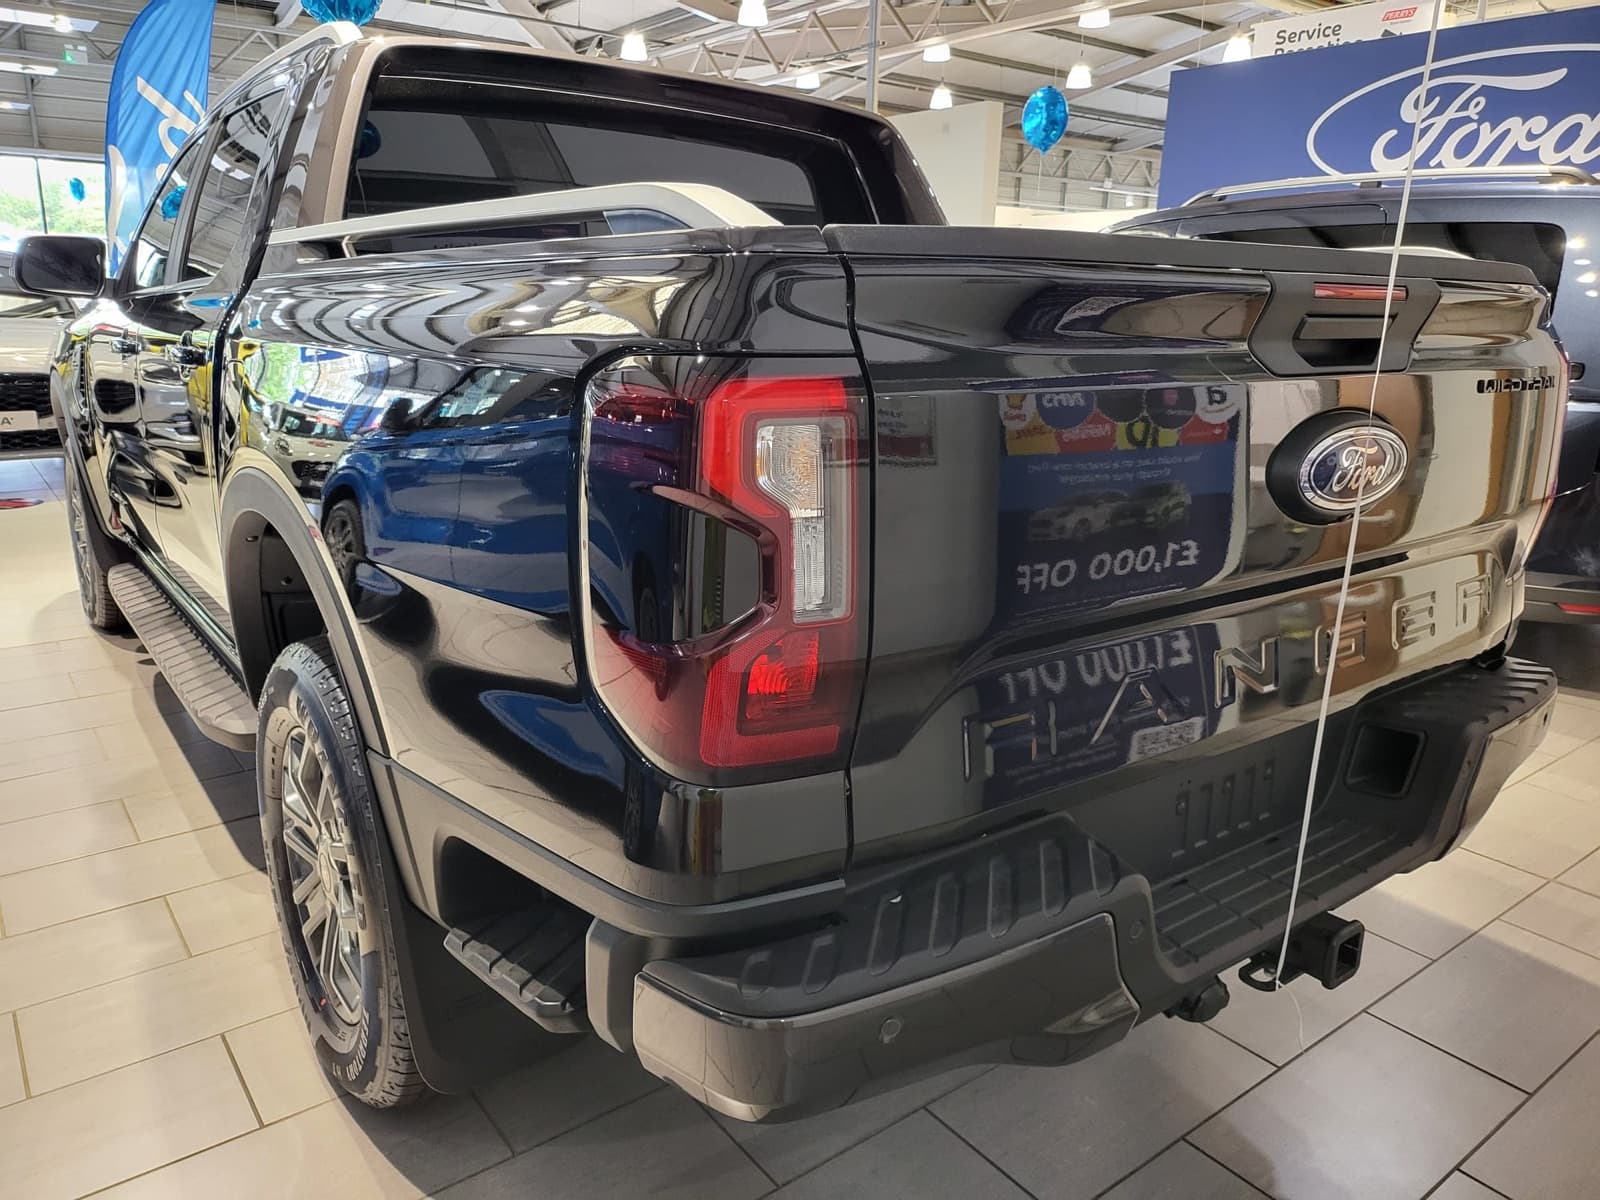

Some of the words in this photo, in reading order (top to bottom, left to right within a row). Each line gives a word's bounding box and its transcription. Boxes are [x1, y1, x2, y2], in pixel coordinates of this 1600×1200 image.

[1383, 8, 1417, 21] PERRYS
[1275, 23, 1343, 46] Service
[1332, 446, 1391, 492] Ford
[963, 572, 1494, 782] RANGER
